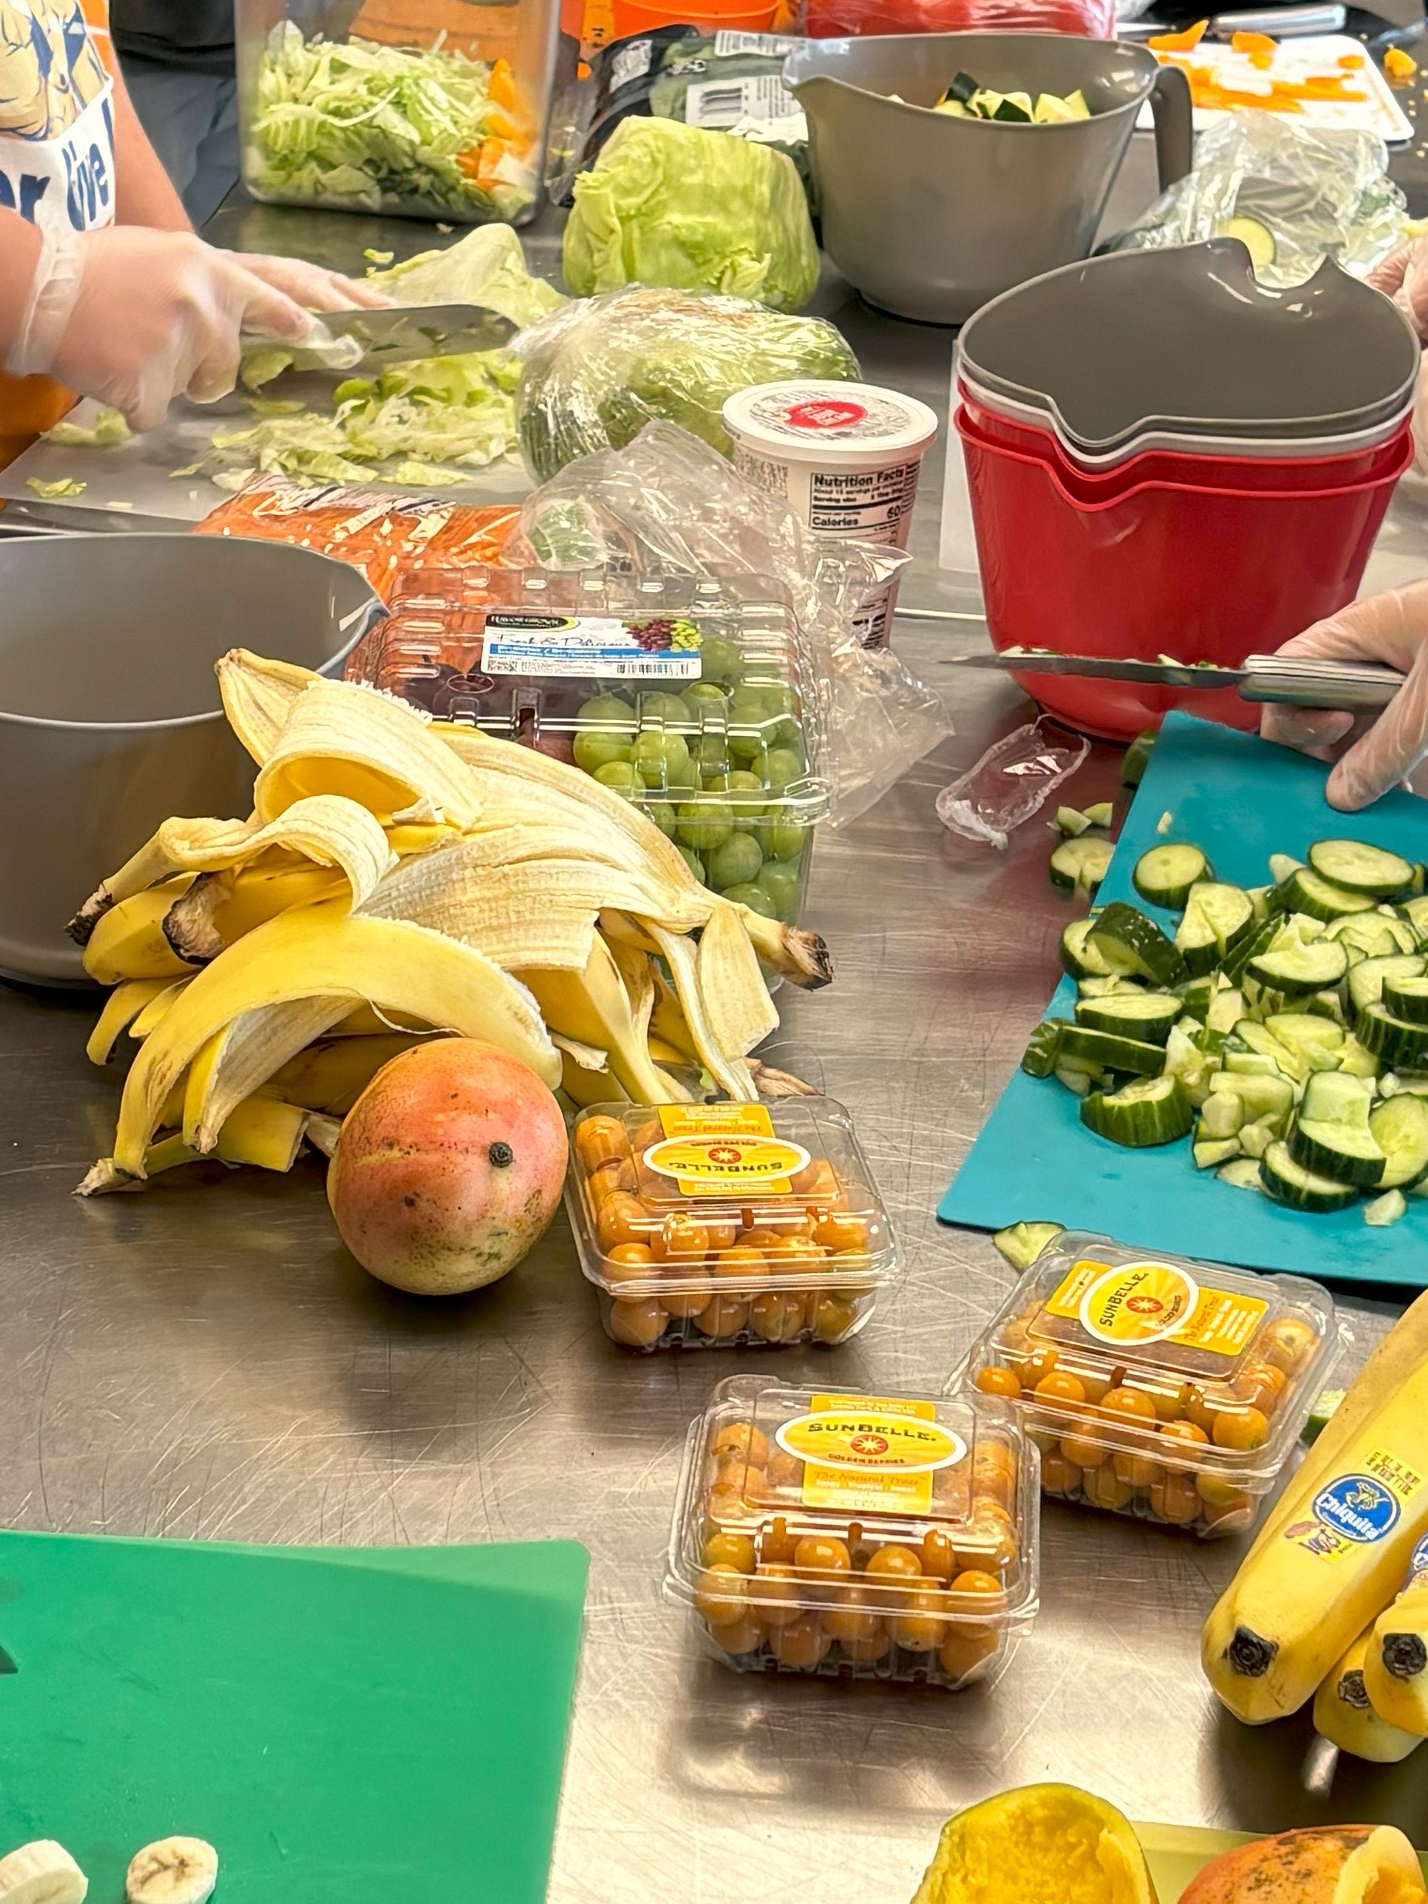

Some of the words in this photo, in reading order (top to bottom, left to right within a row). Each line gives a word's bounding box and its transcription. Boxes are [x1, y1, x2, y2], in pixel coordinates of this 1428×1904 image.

[813, 474, 874, 488] Nutrition
[876, 467, 905, 484] Facts
[811, 517, 859, 527] Calories
[886, 504, 902, 520] 60
[669, 1162, 783, 1174] SUNBELLE
[1098, 1272, 1150, 1327] SUNBELLE
[807, 1422, 933, 1441] SUNBELLE
[1315, 1492, 1380, 1540] Chiquita
